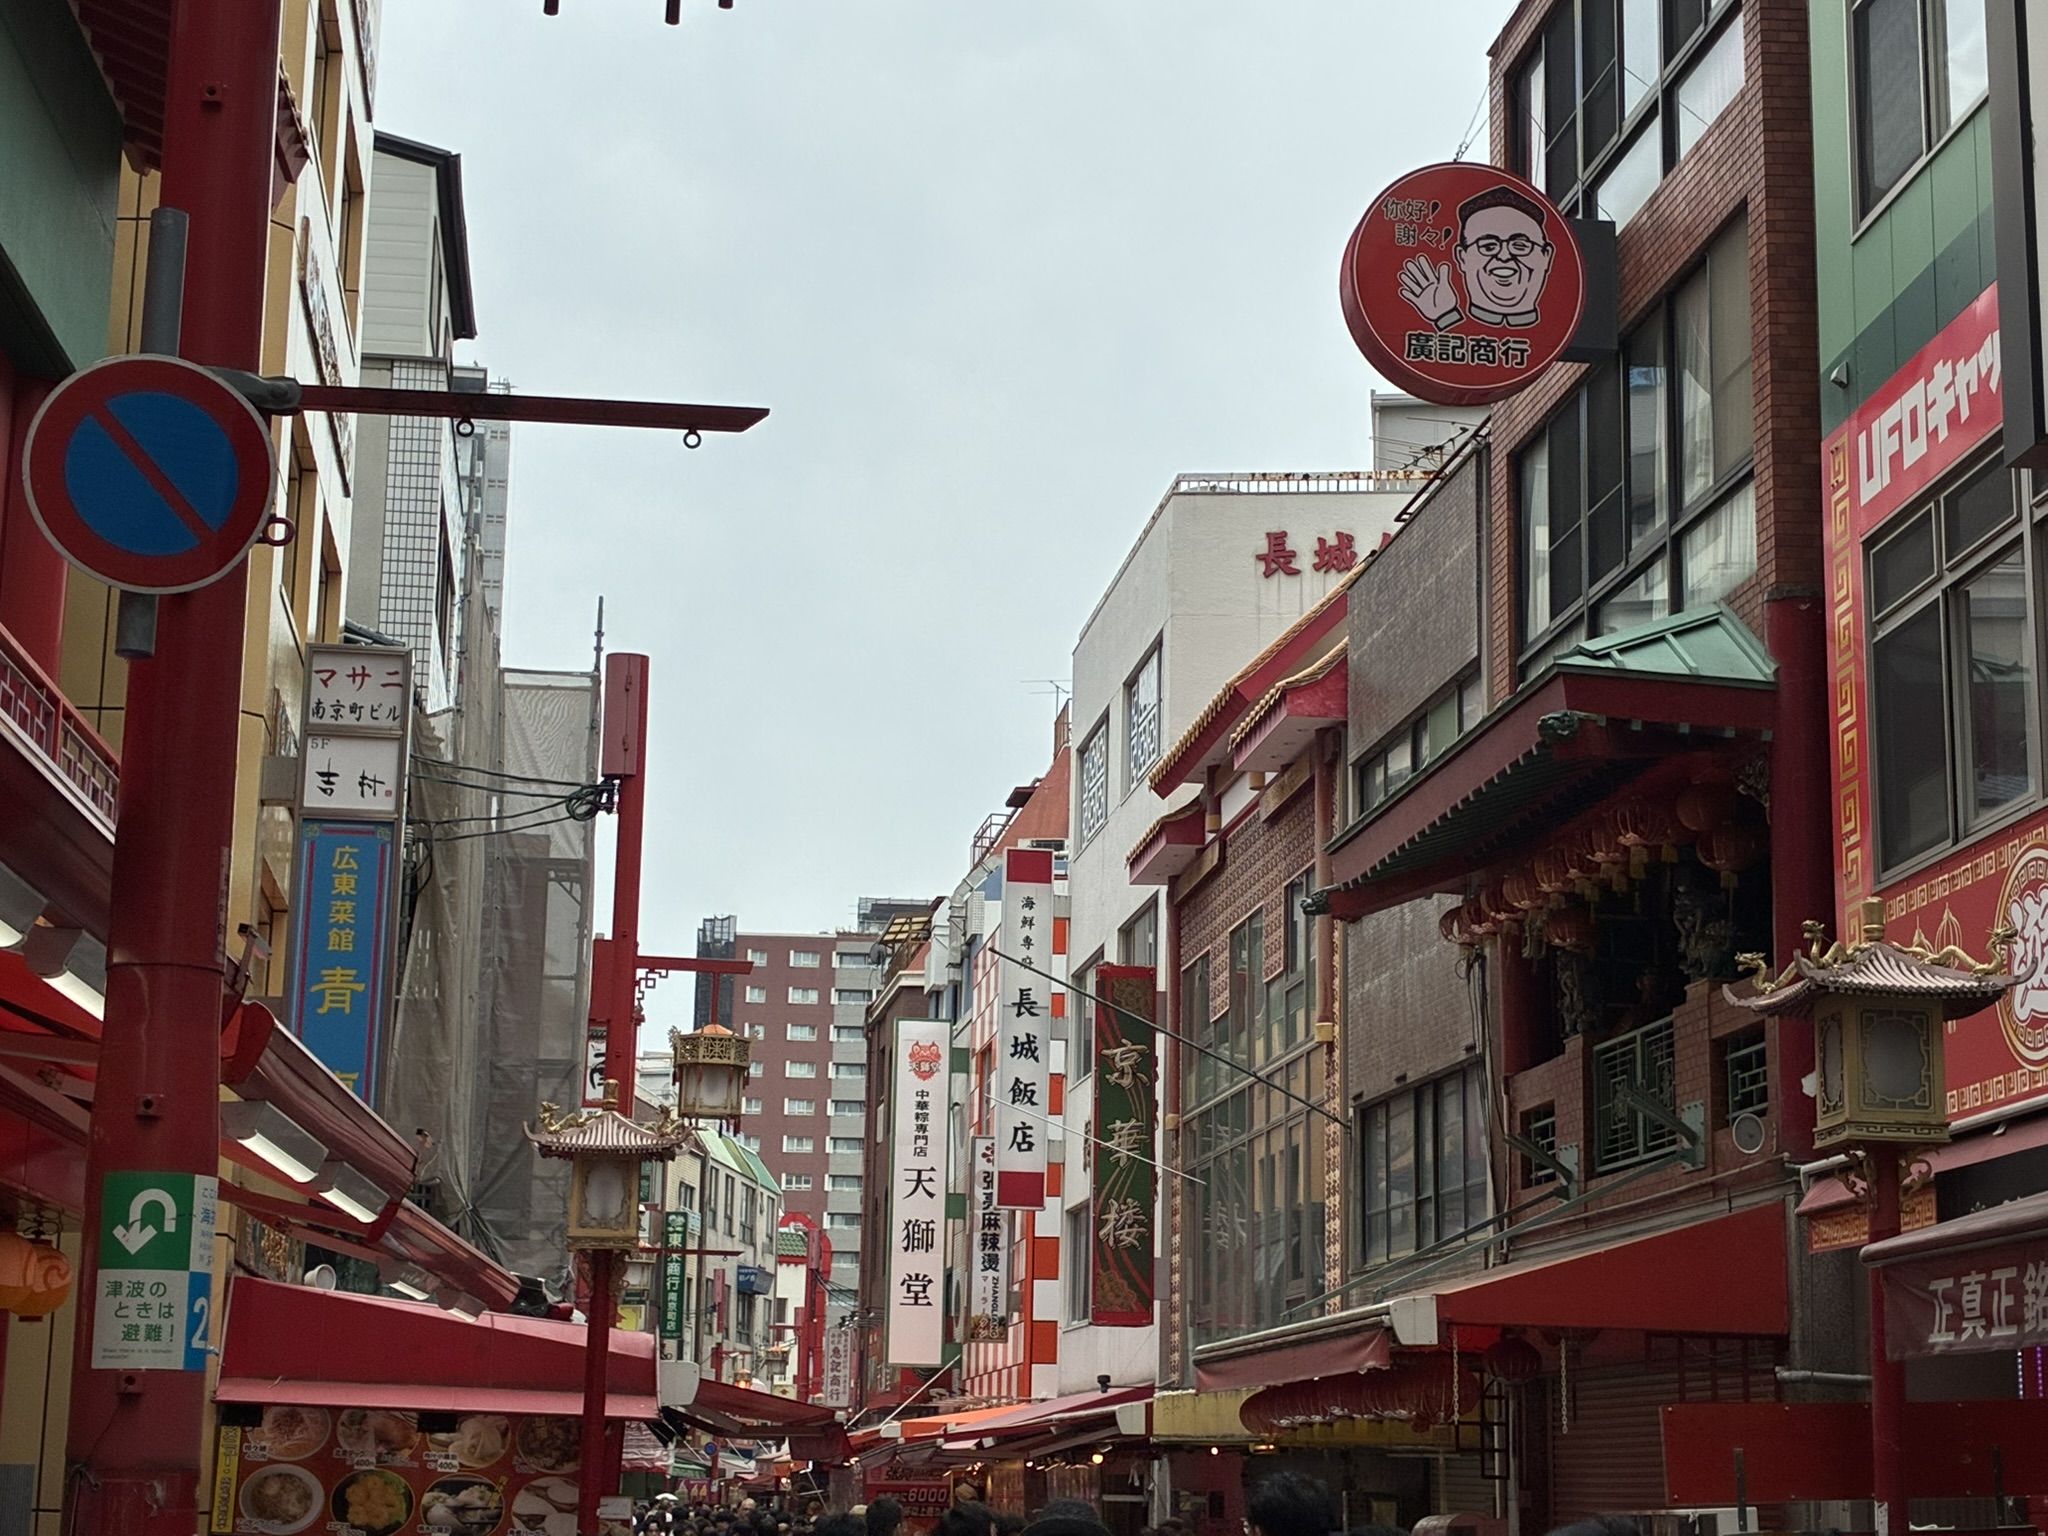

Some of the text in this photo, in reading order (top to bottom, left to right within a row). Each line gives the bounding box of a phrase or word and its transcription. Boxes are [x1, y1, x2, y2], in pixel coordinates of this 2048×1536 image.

[1382, 198, 1441, 223] 你好!
[1395, 223, 1453, 250] 謝々!
[1405, 331, 1531, 368] 廣記商行
[1256, 531, 1391, 578] 長城
[313, 665, 403, 691] マサニ
[311, 698, 400, 722] 南京町ビル
[311, 738, 331, 749] 5F
[328, 846, 360, 952] 広東菜館
[1008, 987, 1041, 1153] 長城飯店
[1099, 1038, 1150, 1250] 京華楼
[899, 1166, 936, 1307] 天獅堂
[105, 1280, 167, 1298] 津波の
[114, 1302, 175, 1319] ときは
[991, 1275, 999, 1338] ZHANGLIANG
[121, 1323, 174, 1343] 避難!
[907, 1487, 947, 1503] 6000
